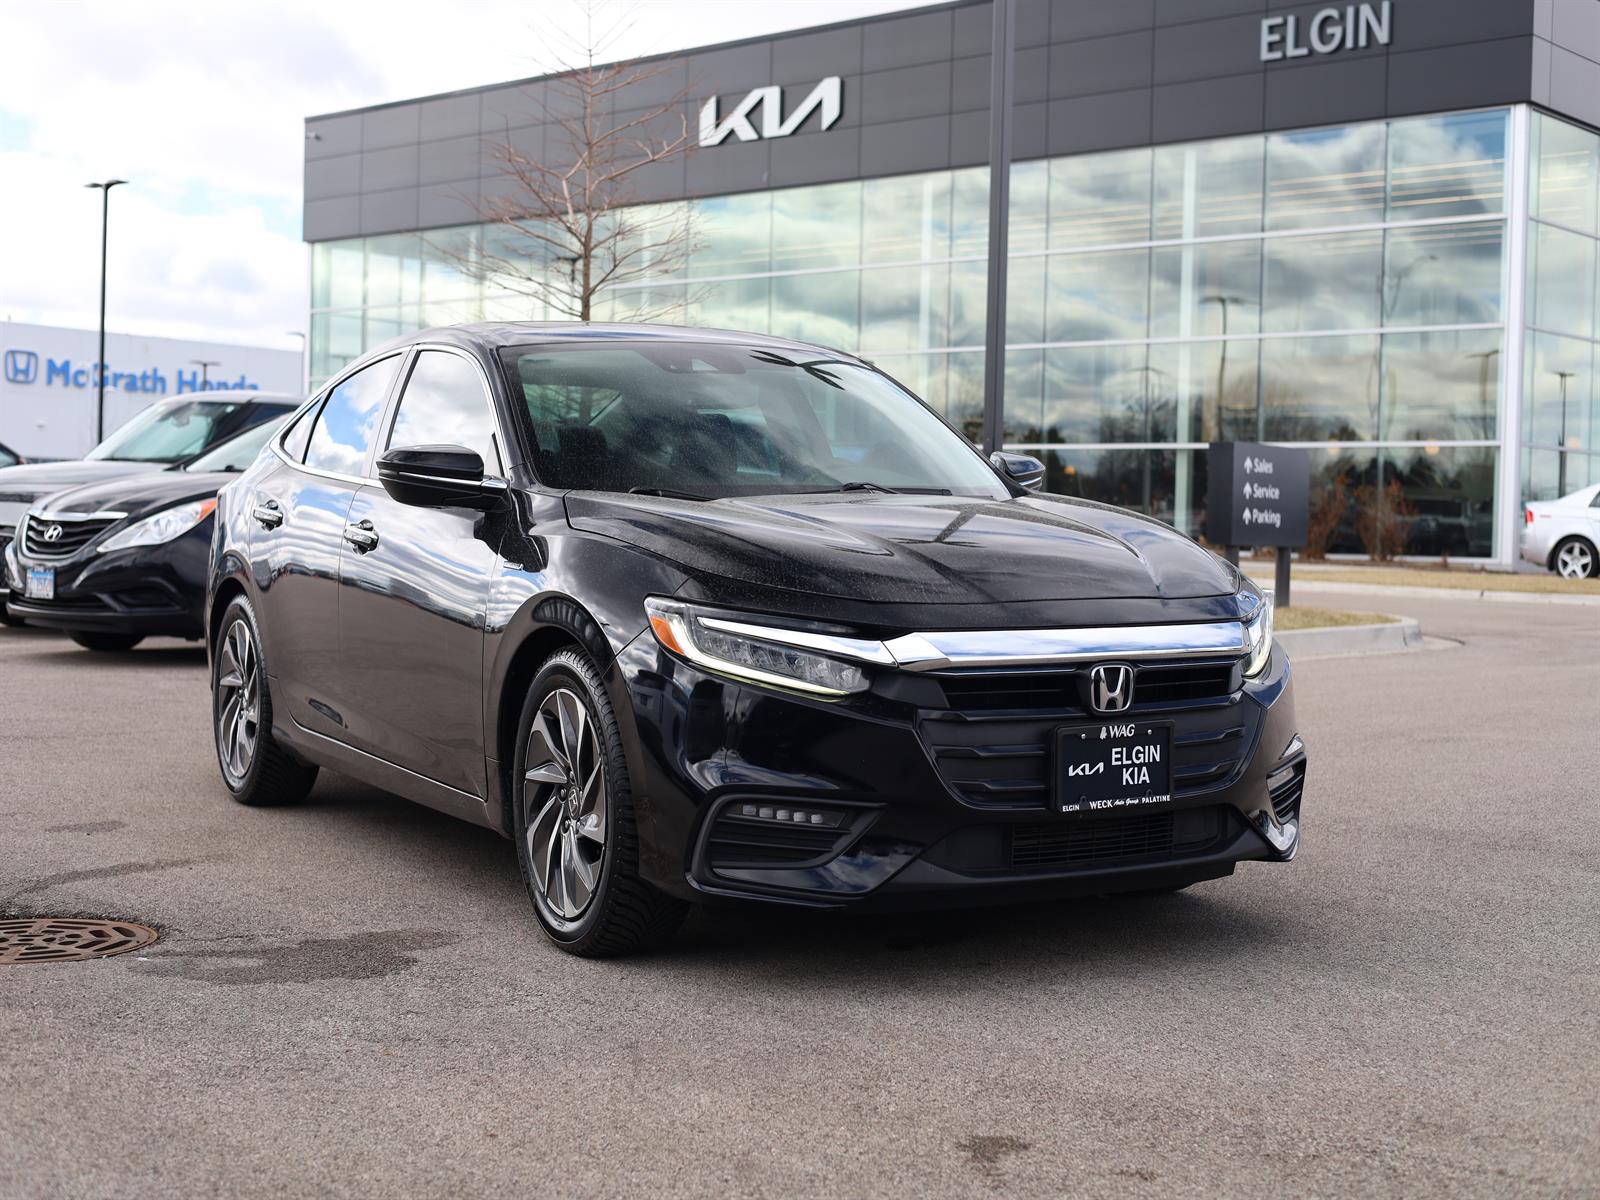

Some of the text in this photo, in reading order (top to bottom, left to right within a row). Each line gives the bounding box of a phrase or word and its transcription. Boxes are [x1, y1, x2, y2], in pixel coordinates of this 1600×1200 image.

[1259, 0, 1393, 62] ELGIN
[698, 75, 845, 148] KIA
[46, 358, 167, 394] McGrath
[1254, 457, 1273, 473] Sales
[1252, 482, 1280, 500] Service
[1252, 508, 1281, 528] Parking
[1109, 724, 1135, 739] WAG
[1112, 745, 1160, 765] ELGIN
[1068, 762, 1104, 777] KIA
[1122, 766, 1150, 786] KIA
[1062, 804, 1080, 812] ELGIN
[1089, 799, 1113, 810] WECK
[1141, 794, 1171, 804] PALATINE
